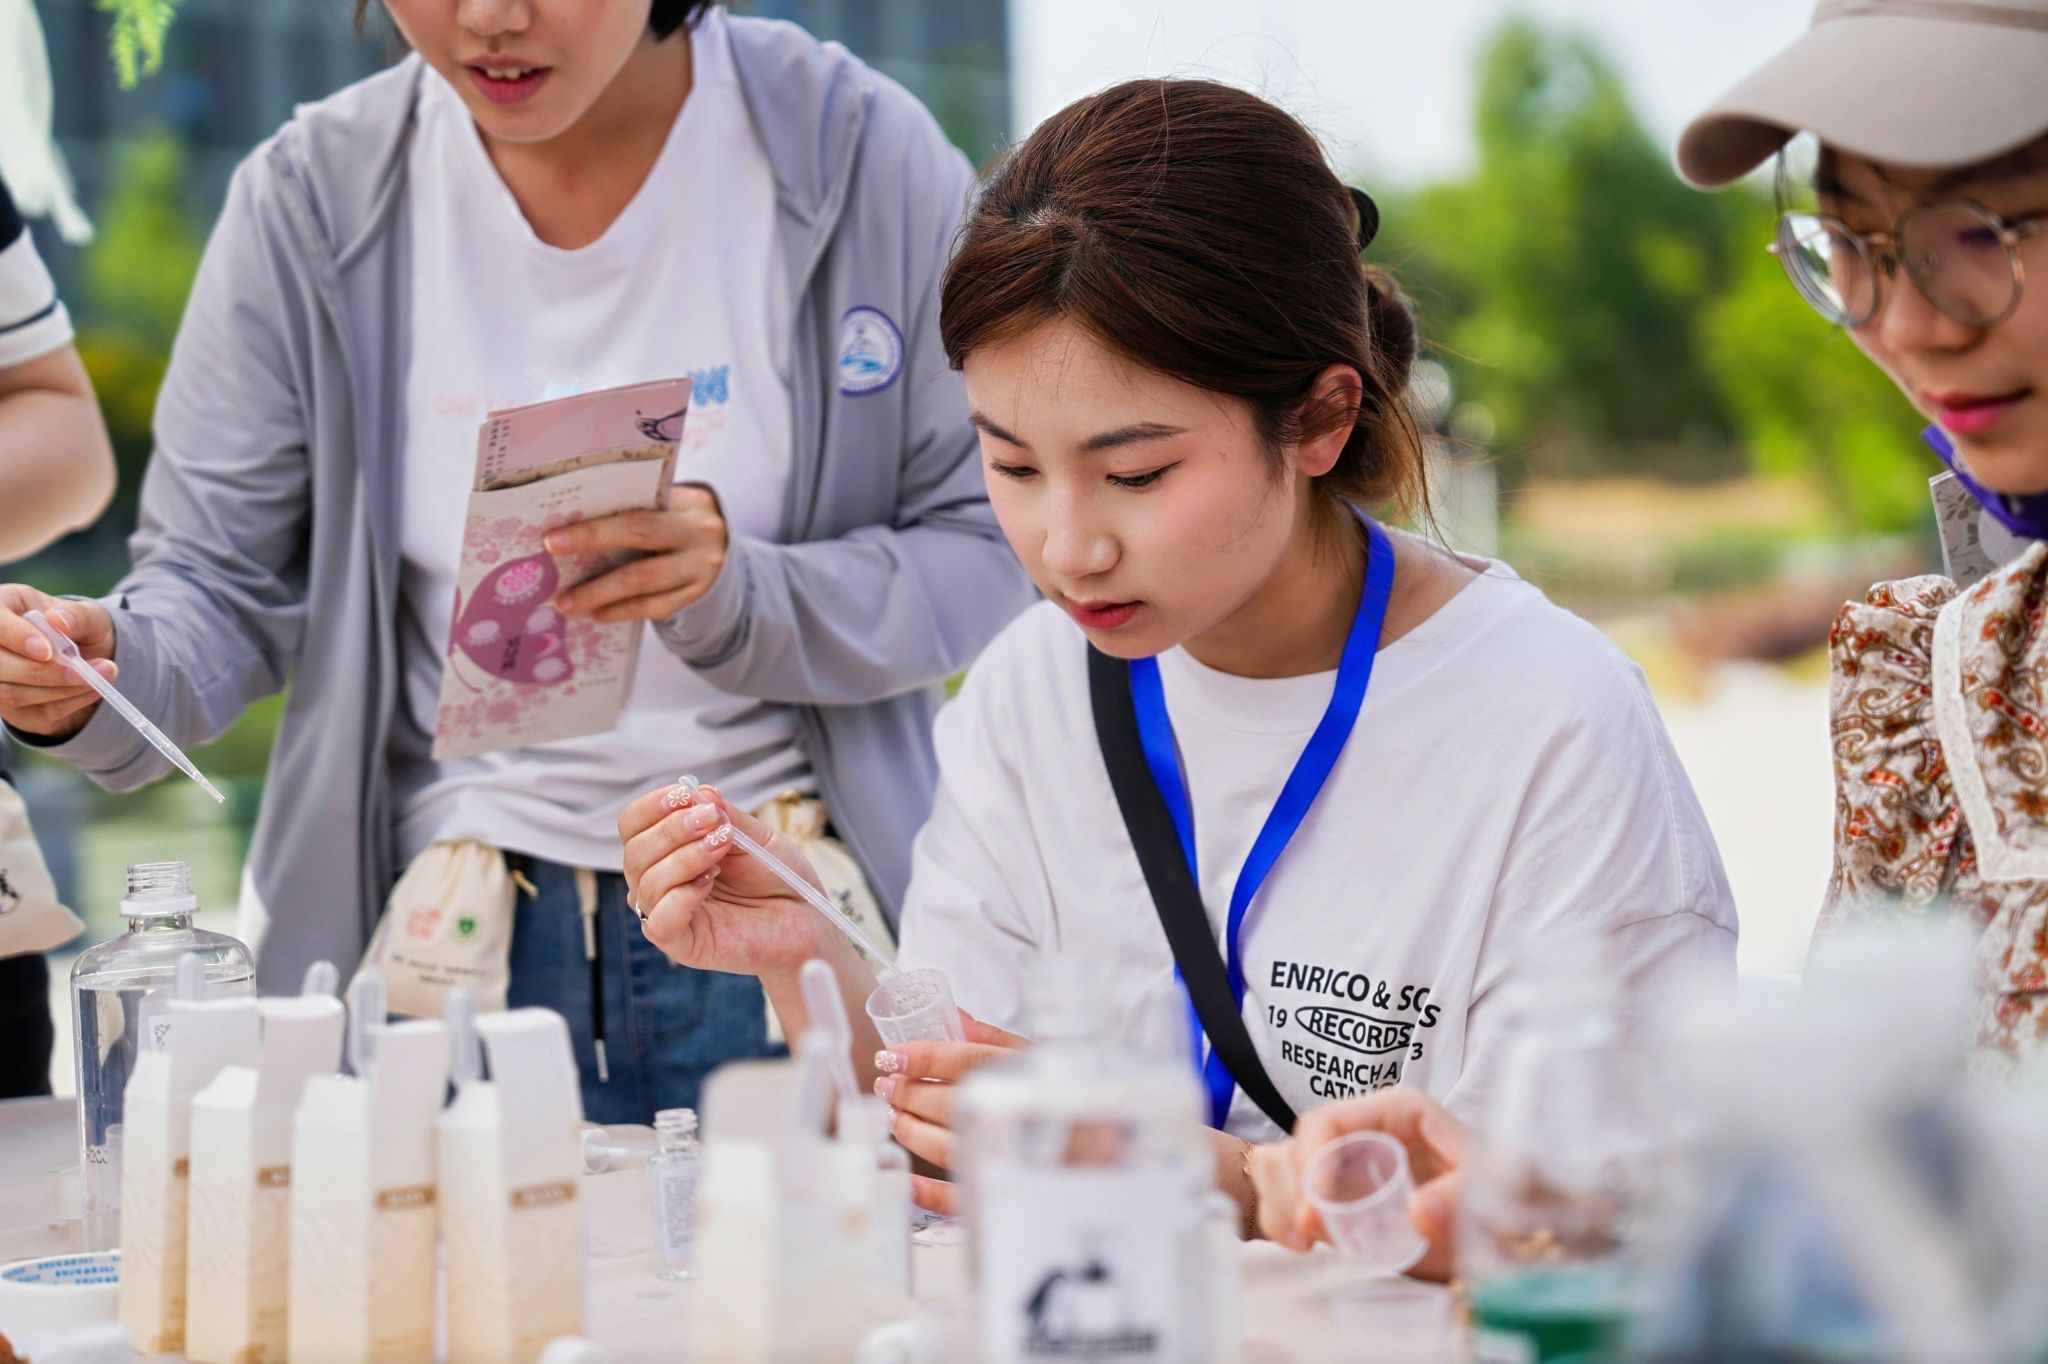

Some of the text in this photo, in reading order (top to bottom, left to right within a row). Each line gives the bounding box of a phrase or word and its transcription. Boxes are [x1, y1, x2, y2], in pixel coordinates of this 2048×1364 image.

[1270, 961, 1370, 1002] ENRICO
[1372, 980, 1391, 1010] &
[1267, 1005, 1424, 1060] 19 RECORDS 3
[1281, 1040, 1383, 1085] RESEARCH
